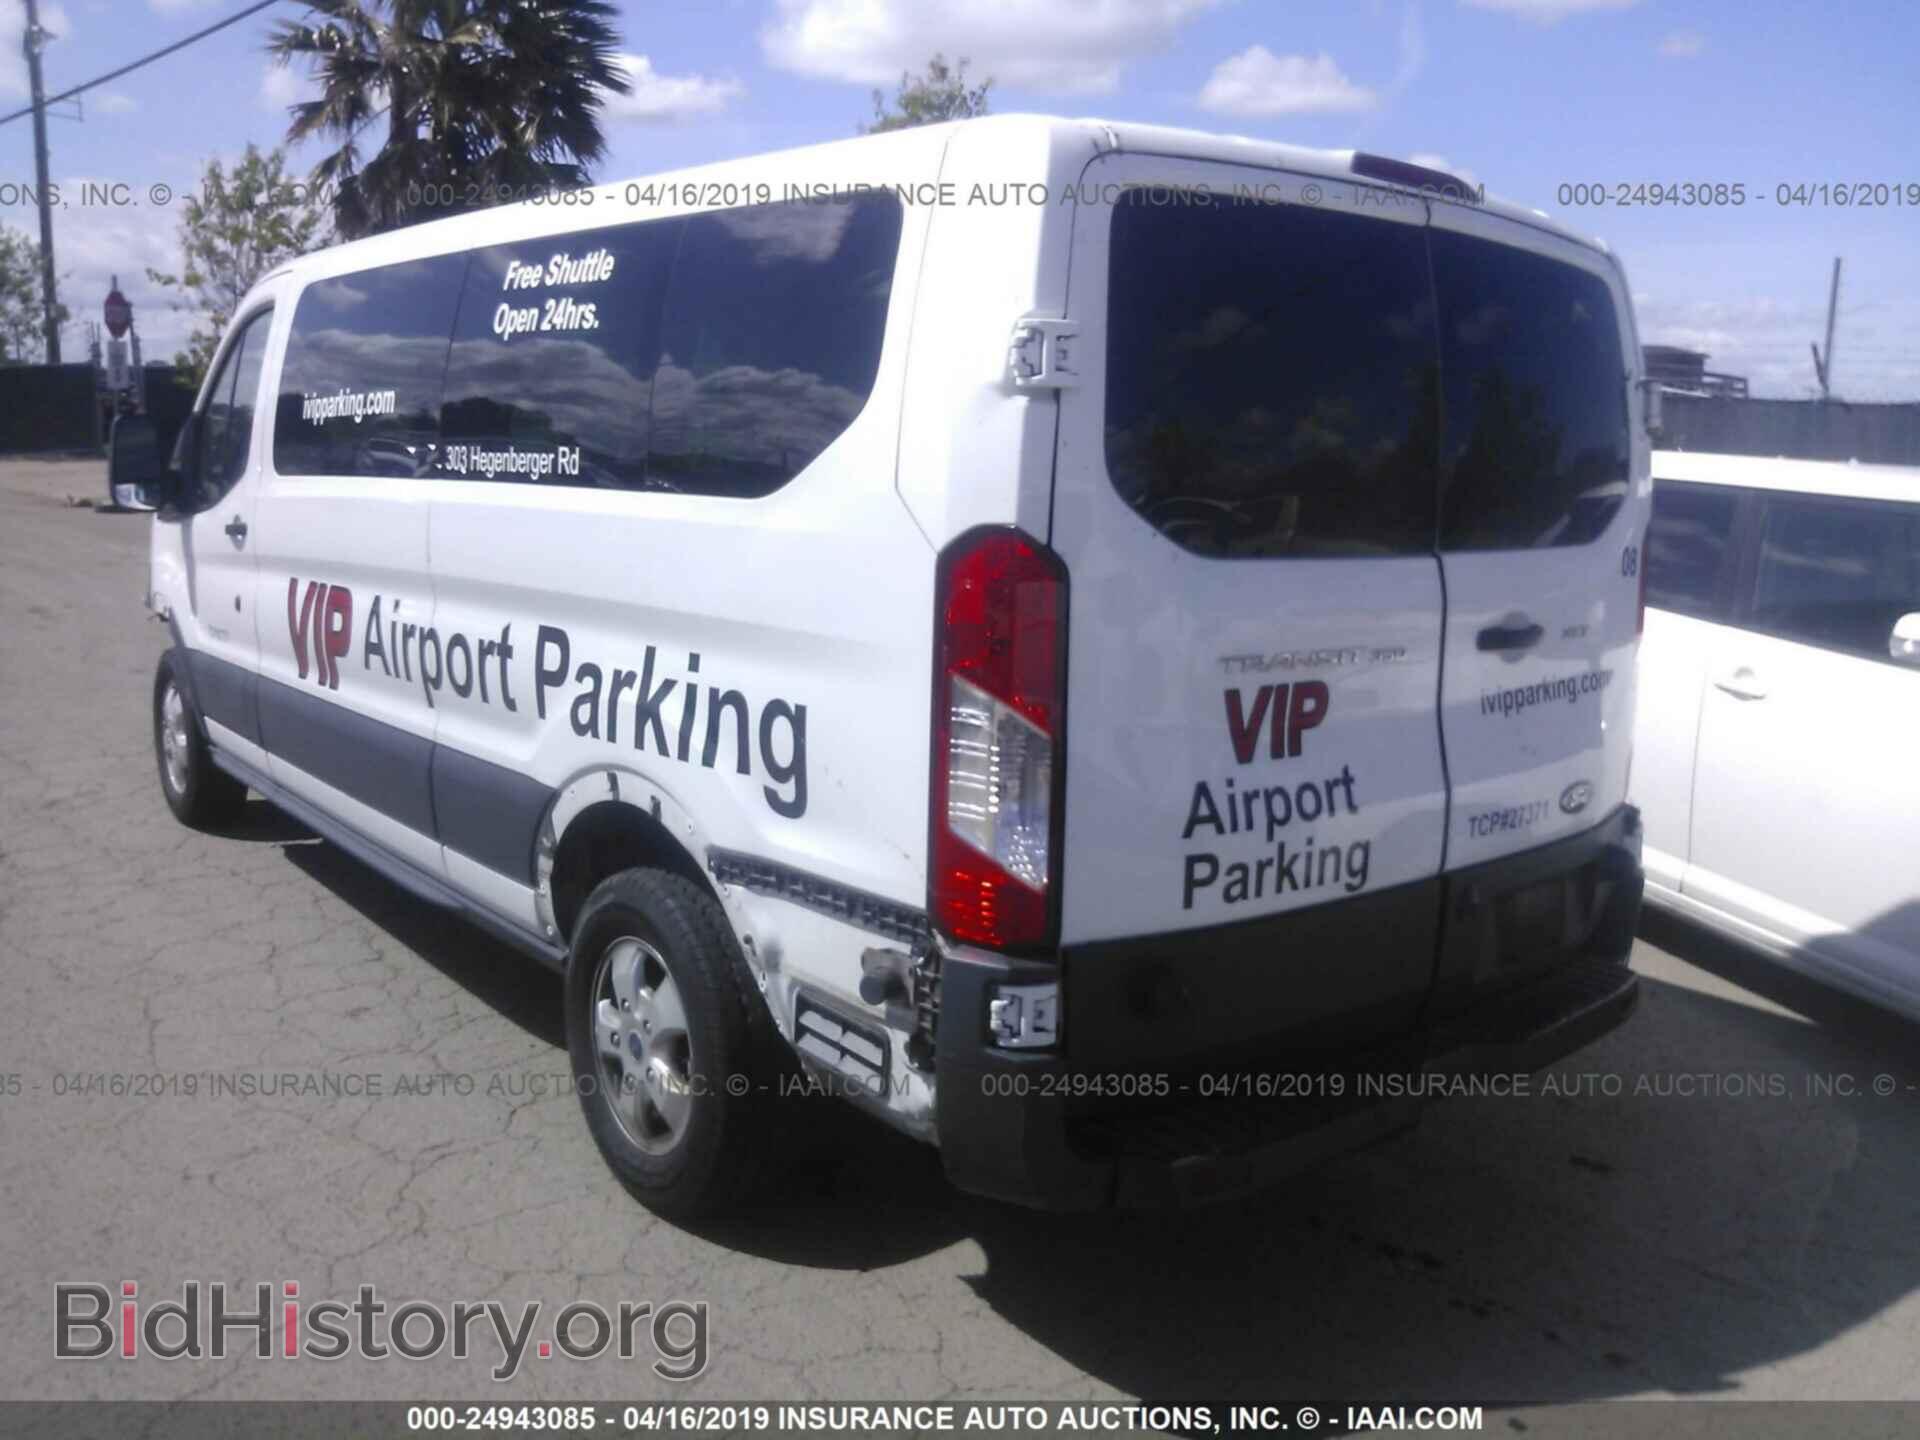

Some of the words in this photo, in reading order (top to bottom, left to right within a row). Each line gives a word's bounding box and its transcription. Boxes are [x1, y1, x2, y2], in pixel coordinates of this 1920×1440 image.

[503, 260, 543, 291] Free
[544, 248, 615, 287] Shuttle
[493, 302, 540, 342] Open
[540, 297, 600, 332] 24hrs.
[303, 388, 396, 425] ivipparking.com
[469, 446, 555, 480] Hegenberger
[557, 446, 580, 475] Rd
[287, 577, 352, 691] VIP
[364, 594, 518, 708] Airport
[533, 624, 808, 820] Parking
[1224, 679, 1330, 765] VIP
[1181, 764, 1359, 842] Airport
[1182, 836, 1372, 911] Parking
